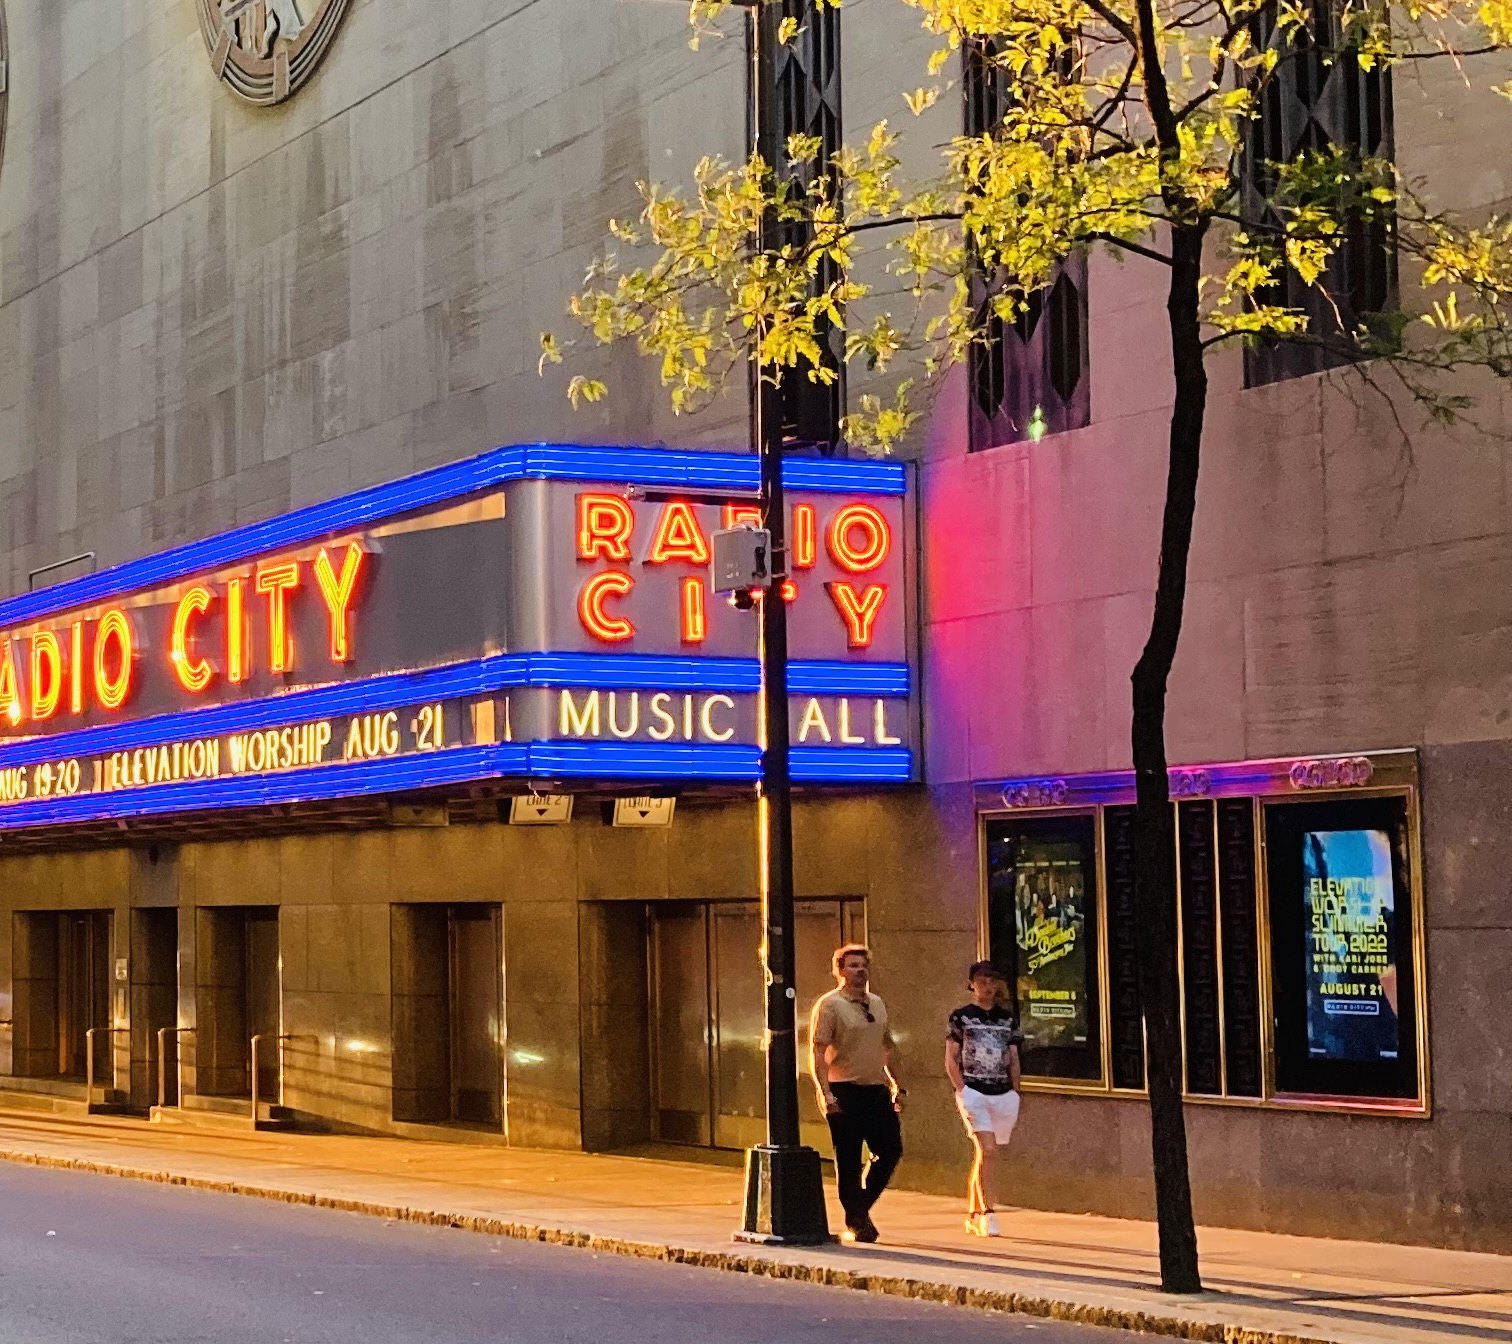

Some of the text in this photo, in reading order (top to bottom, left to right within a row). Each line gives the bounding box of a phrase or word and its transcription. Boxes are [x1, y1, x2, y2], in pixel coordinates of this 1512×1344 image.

[171, 539, 365, 693] CITY
[578, 570, 887, 648] CIY
[560, 689, 901, 745] MUSIC ALL
[34, 758, 81, 797] 19-20
[110, 738, 220, 789] ELEVATION
[229, 721, 332, 774] WORSHIP
[346, 711, 399, 760] AUG
[416, 704, 444, 750] 21
[1310, 877, 1381, 896] ELEVATIO
[1311, 896, 1385, 914] WORSHP
[1350, 933, 1388, 953] 2022
[1320, 982, 1383, 996] AUGUST 21
